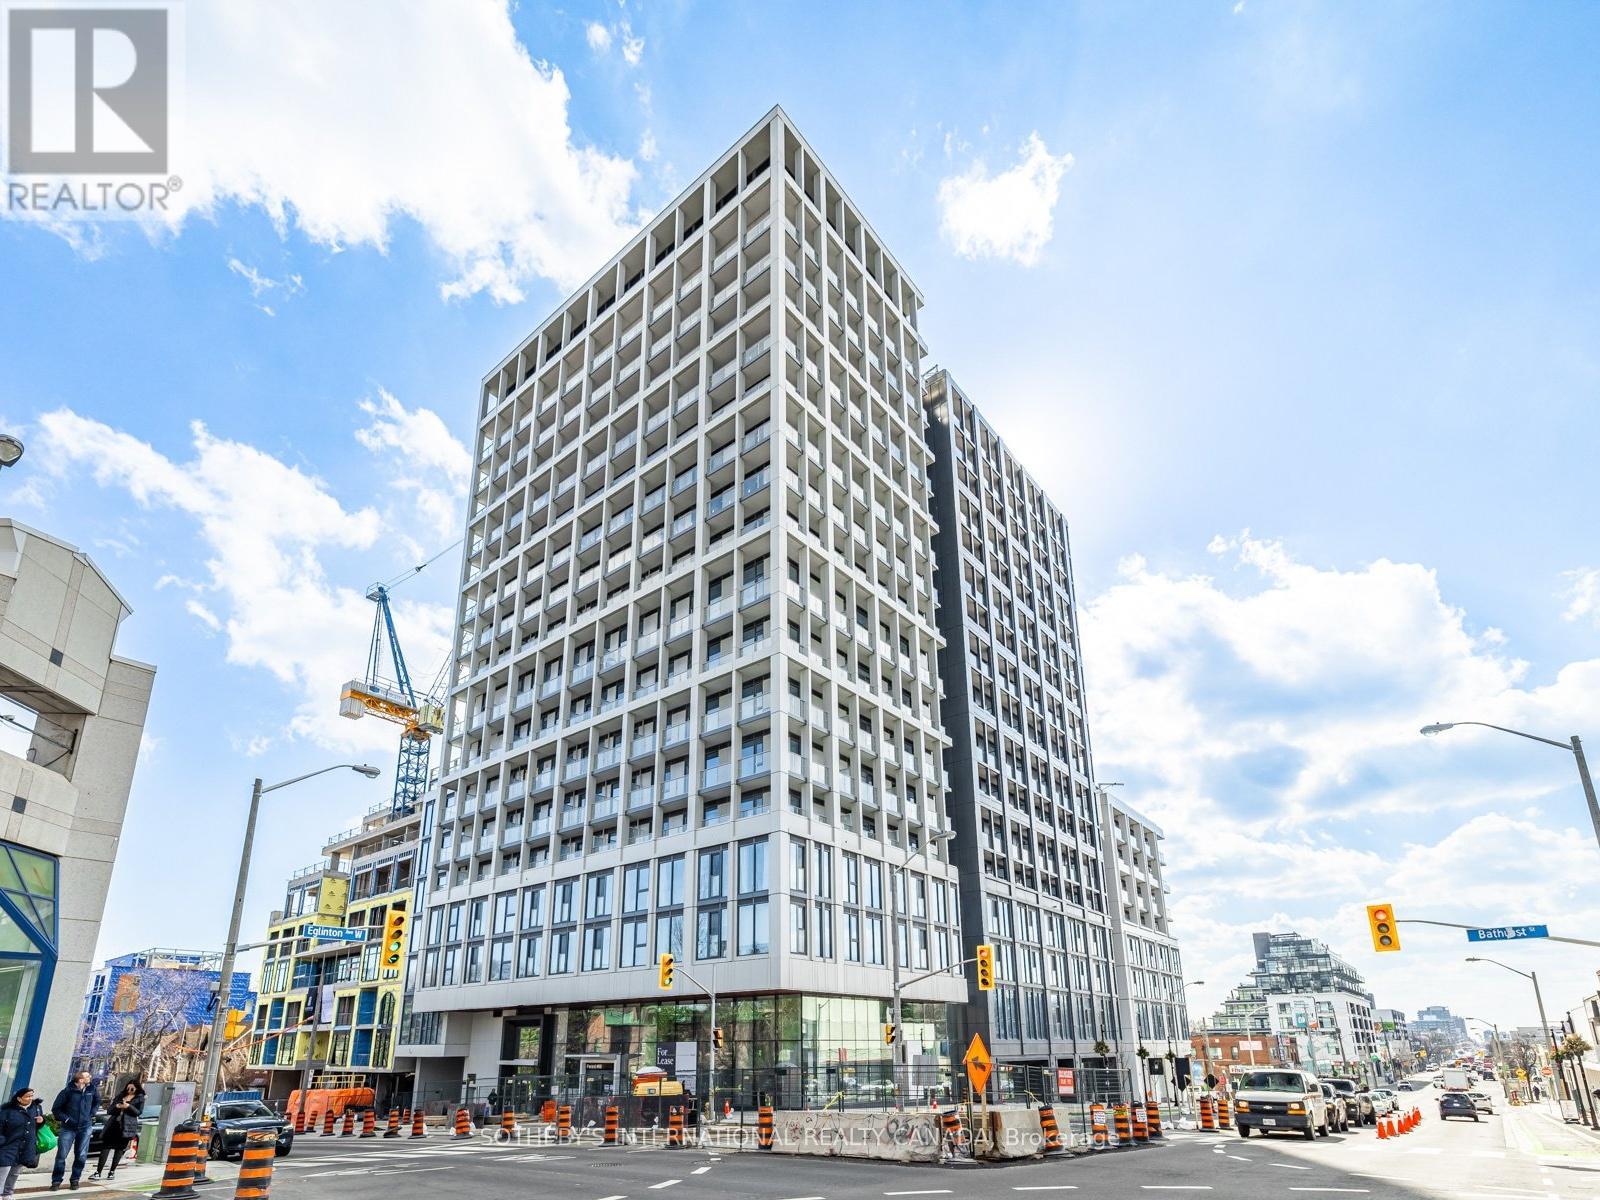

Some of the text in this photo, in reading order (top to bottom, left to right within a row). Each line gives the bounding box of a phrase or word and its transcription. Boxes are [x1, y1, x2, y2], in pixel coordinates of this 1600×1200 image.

[307, 926, 343, 937] Eglinton
[354, 930, 363, 939] W
[1478, 927, 1527, 939] Bathust
[657, 1047, 668, 1056] For
[657, 1056, 674, 1065] Lease
